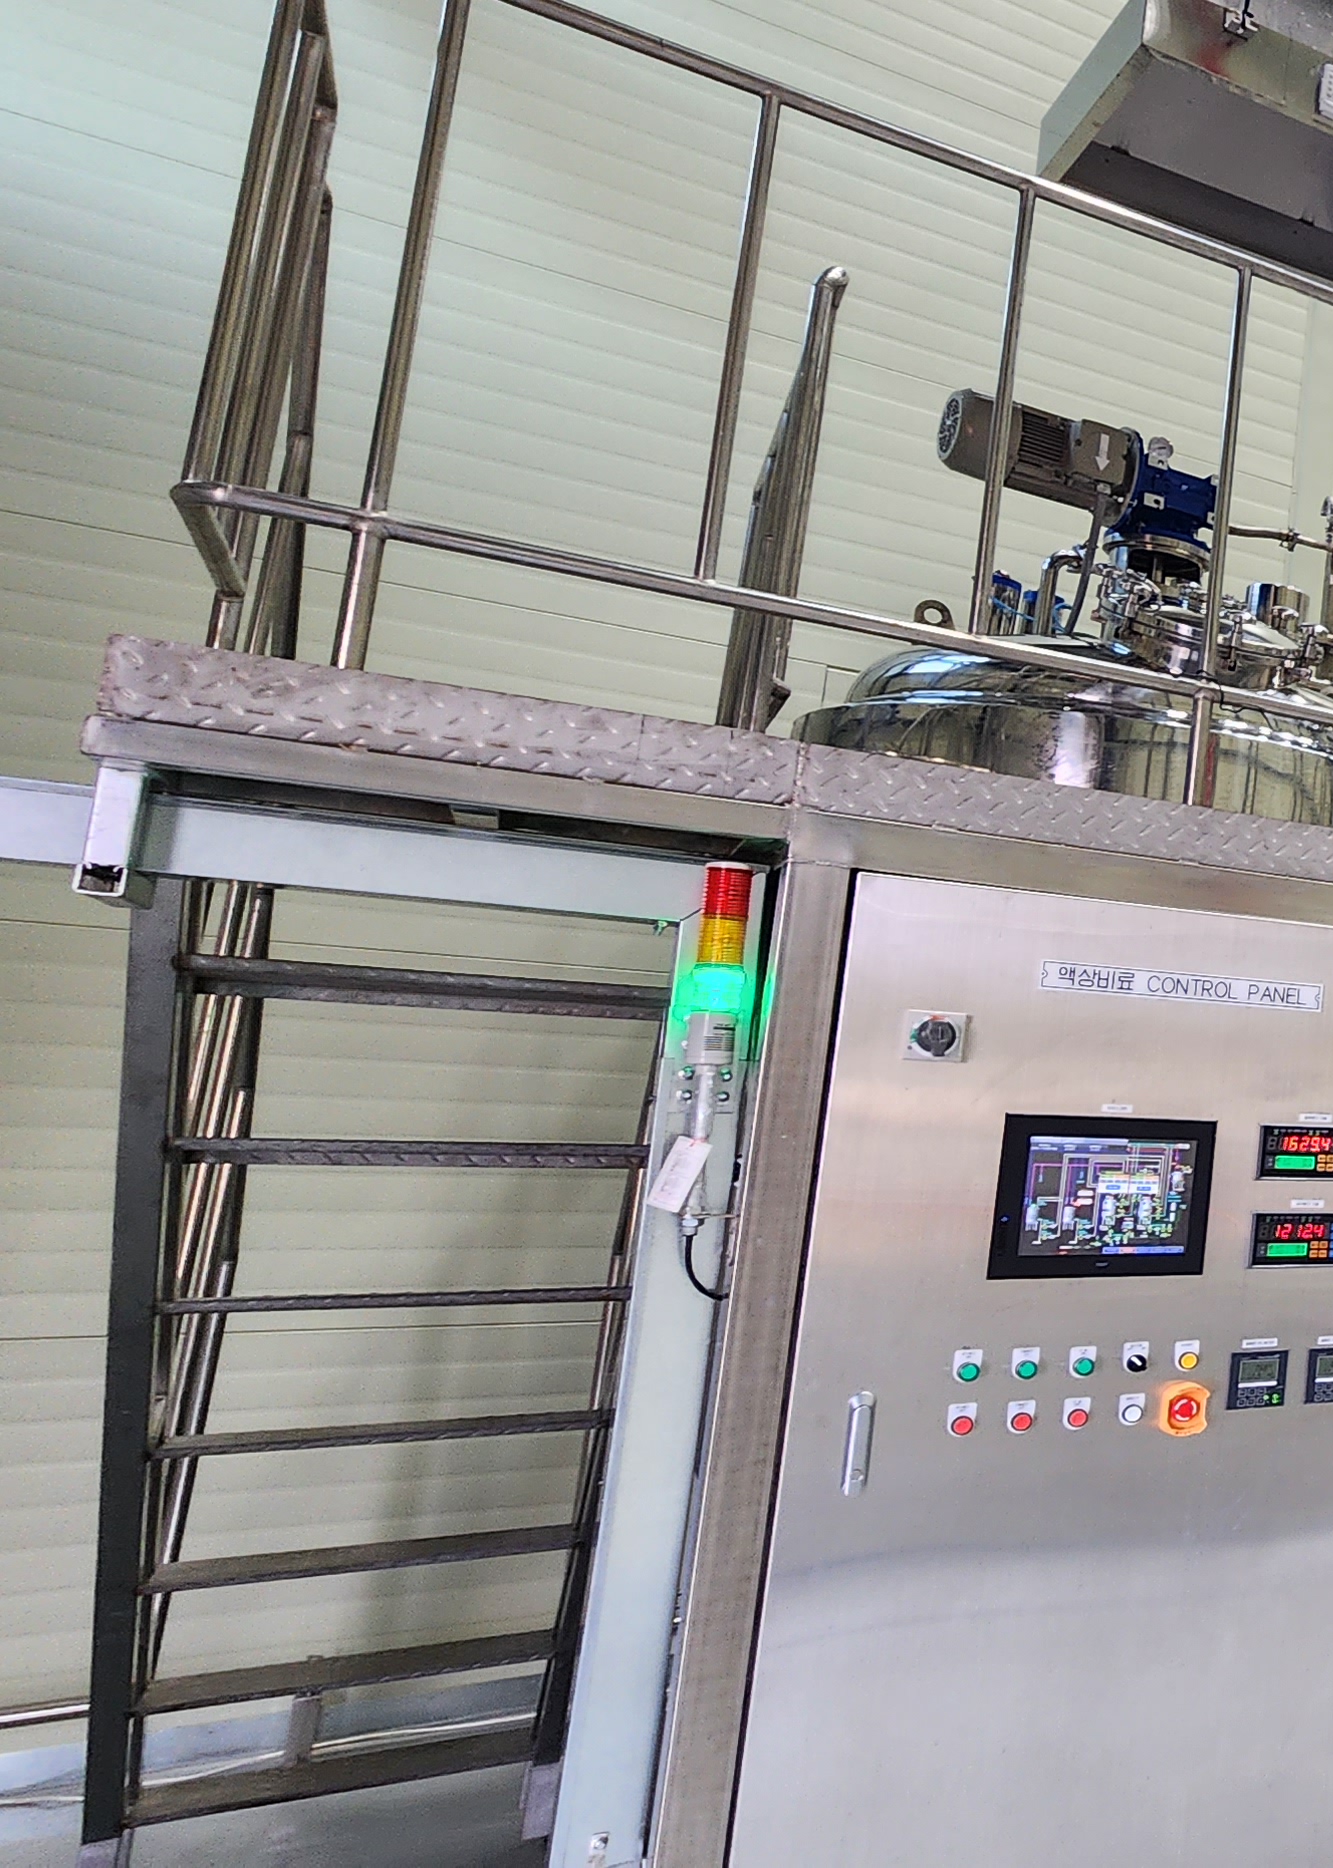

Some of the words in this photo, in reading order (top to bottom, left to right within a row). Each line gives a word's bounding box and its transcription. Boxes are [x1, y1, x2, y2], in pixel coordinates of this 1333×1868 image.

[1057, 965, 1136, 991] 액상비료
[1147, 975, 1238, 1000] CONTROL
[1247, 983, 1307, 1005] PANEL
